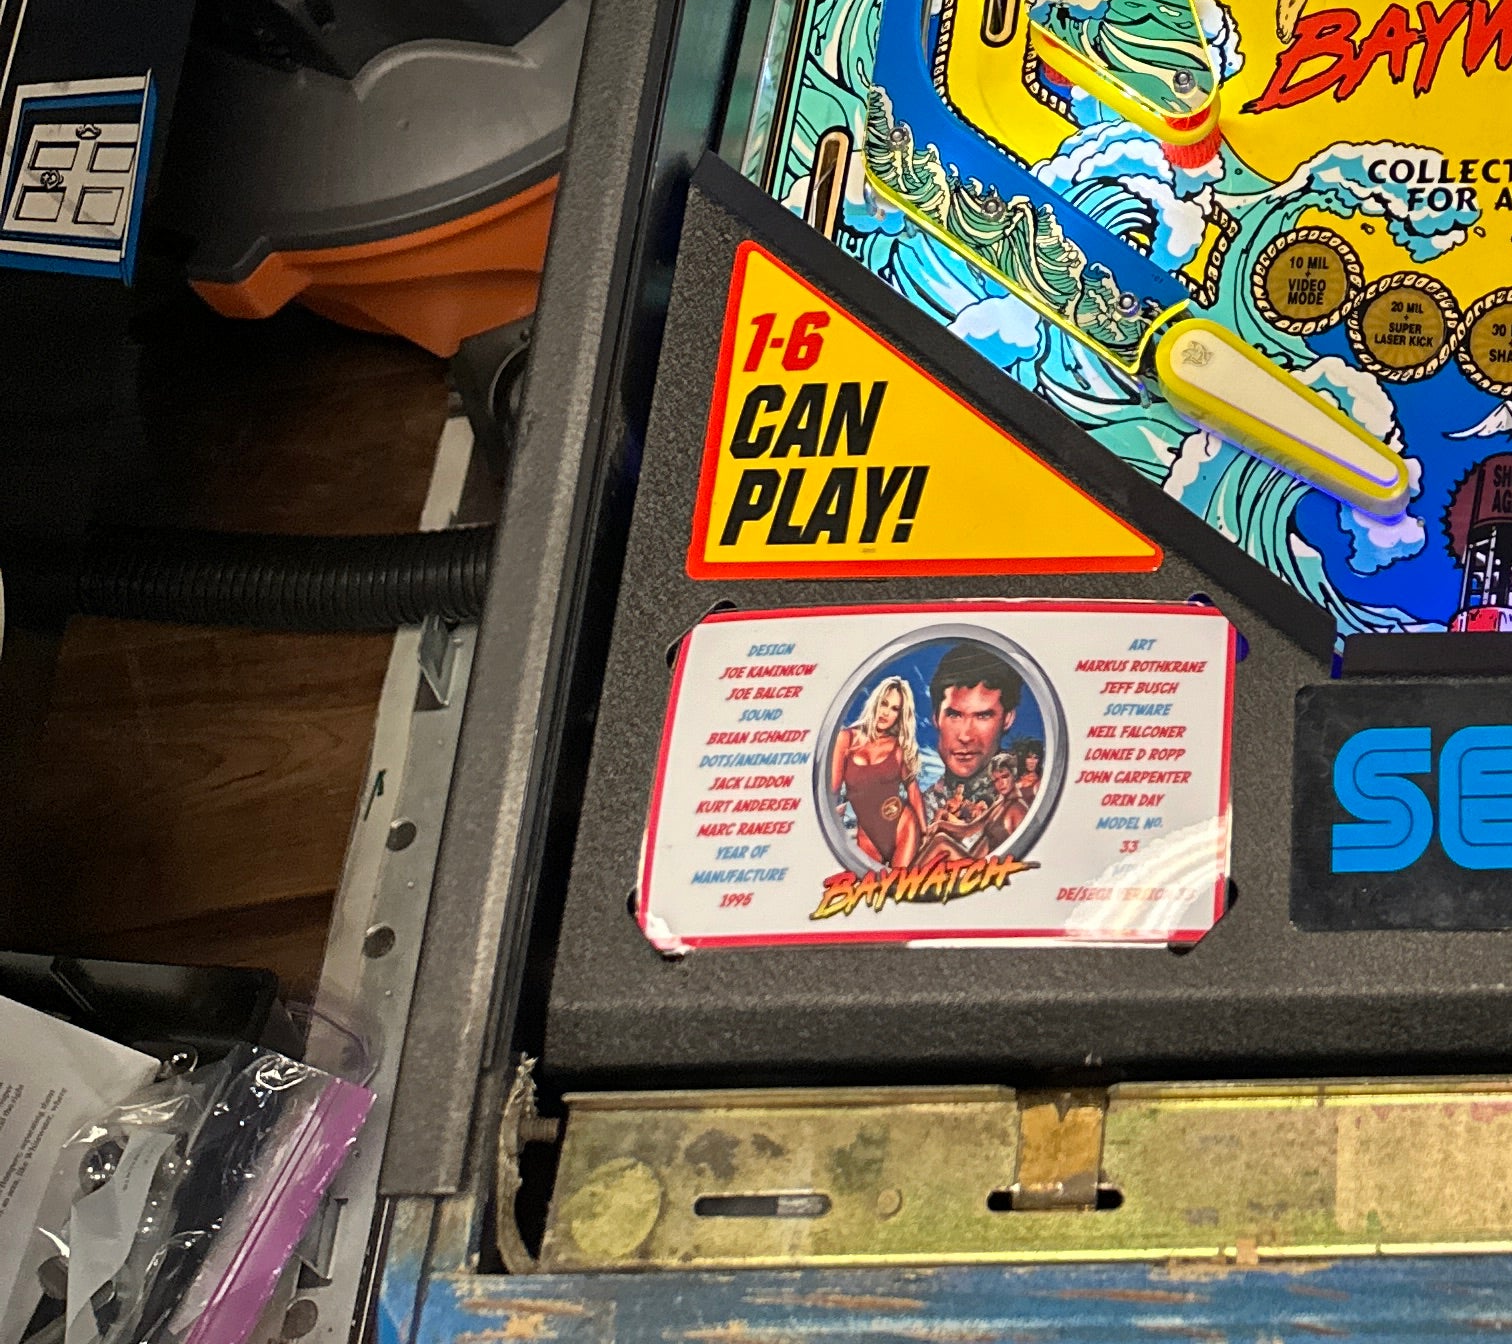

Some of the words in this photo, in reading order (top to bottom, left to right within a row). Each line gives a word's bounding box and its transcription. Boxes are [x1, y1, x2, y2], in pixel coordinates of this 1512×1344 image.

[1406, 187, 1479, 212] FOR
[1288, 278, 1326, 293] VIDEO
[1287, 291, 1324, 305] MODE
[1388, 322, 1422, 334] SUPER
[742, 310, 831, 372] 1-6
[1374, 333, 1406, 346] LASER
[1408, 335, 1434, 348] KICK
[729, 380, 888, 459] CAN
[719, 466, 930, 546] PLAY!
[747, 644, 795, 657] DESIGN
[1128, 639, 1157, 650] ART
[747, 664, 818, 678] KAMINKOW
[1074, 660, 1129, 672] MARKUS
[1130, 661, 1208, 673] ROTHKRANZ
[752, 686, 803, 700] BALCER
[1100, 682, 1134, 694] JEFF
[1134, 682, 1179, 694] BUSCH
[739, 708, 783, 722] SOUND
[1104, 704, 1173, 716] SOFTWARE
[706, 731, 749, 745] BRIAN
[750, 729, 811, 744] SCHMIDT
[1087, 726, 1118, 738] NEIL
[1119, 726, 1187, 739] FALCONER
[699, 752, 811, 768] DOTS/ANIMATION
[1084, 748, 1135, 761] LONNIE
[1149, 748, 1186, 761] ROPP
[708, 777, 744, 791] JACK
[744, 775, 794, 789] LIDDON
[1074, 771, 1113, 784] JOHN
[1113, 771, 1192, 784] CARPENTER
[696, 800, 732, 814] KURT
[733, 798, 801, 812] ANDERSEN
[1101, 794, 1136, 806] ORIN
[1137, 794, 1165, 806] DAY
[697, 823, 736, 837] MARC
[736, 821, 794, 835] RANESES
[1096, 817, 1140, 830] MODEL
[715, 846, 749, 860] YEAR
[691, 867, 789, 884] MANUFACTURE
[809, 851, 1041, 920] BAYWATCH
[719, 893, 754, 908] 1995
